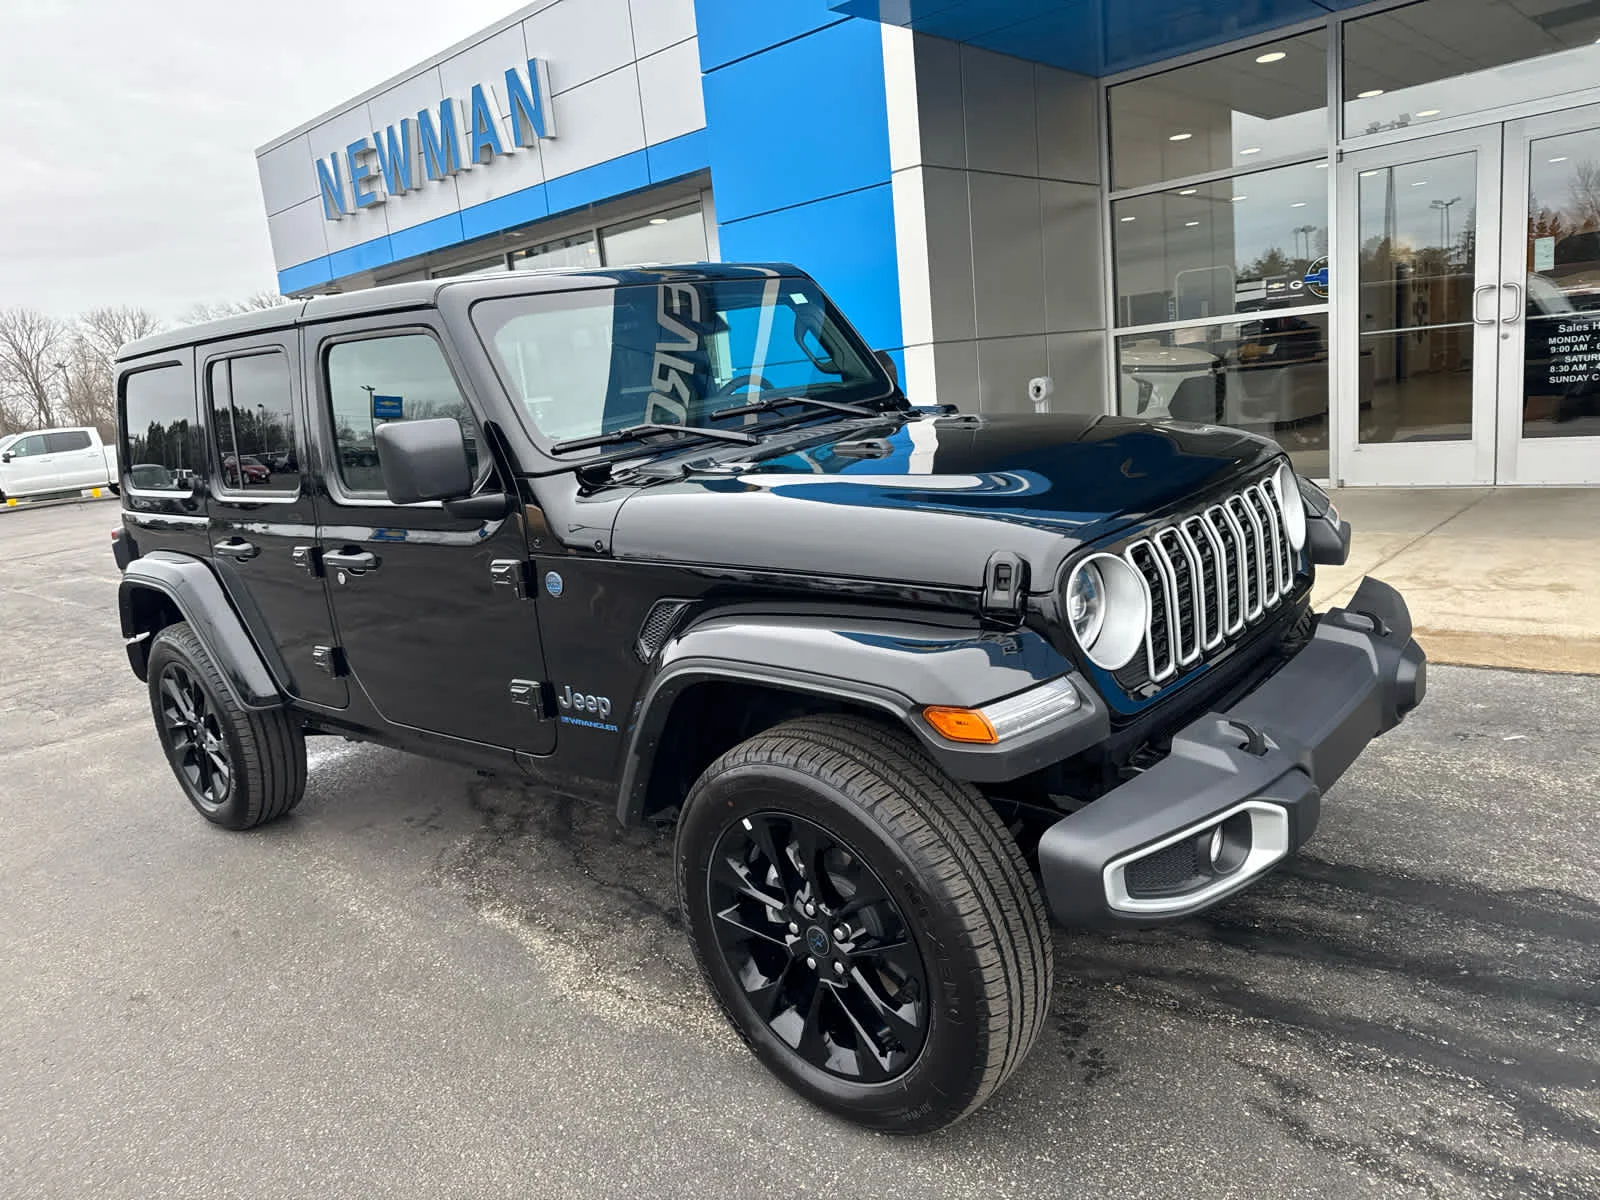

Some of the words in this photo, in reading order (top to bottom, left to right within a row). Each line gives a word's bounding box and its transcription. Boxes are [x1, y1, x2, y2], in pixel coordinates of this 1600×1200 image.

[316, 57, 554, 220] NEWMAN
[1289, 280, 1303, 289] G
[1558, 323, 1589, 333] Sales
[1548, 334, 1591, 345] MONDAY
[1550, 345, 1570, 354] 9:00
[1572, 344, 1588, 352] AM
[1550, 364, 1570, 373] 8:30
[1571, 363, 1587, 372] AM
[1548, 374, 1589, 384] SUNDAY
[558, 685, 612, 720] Jeep
